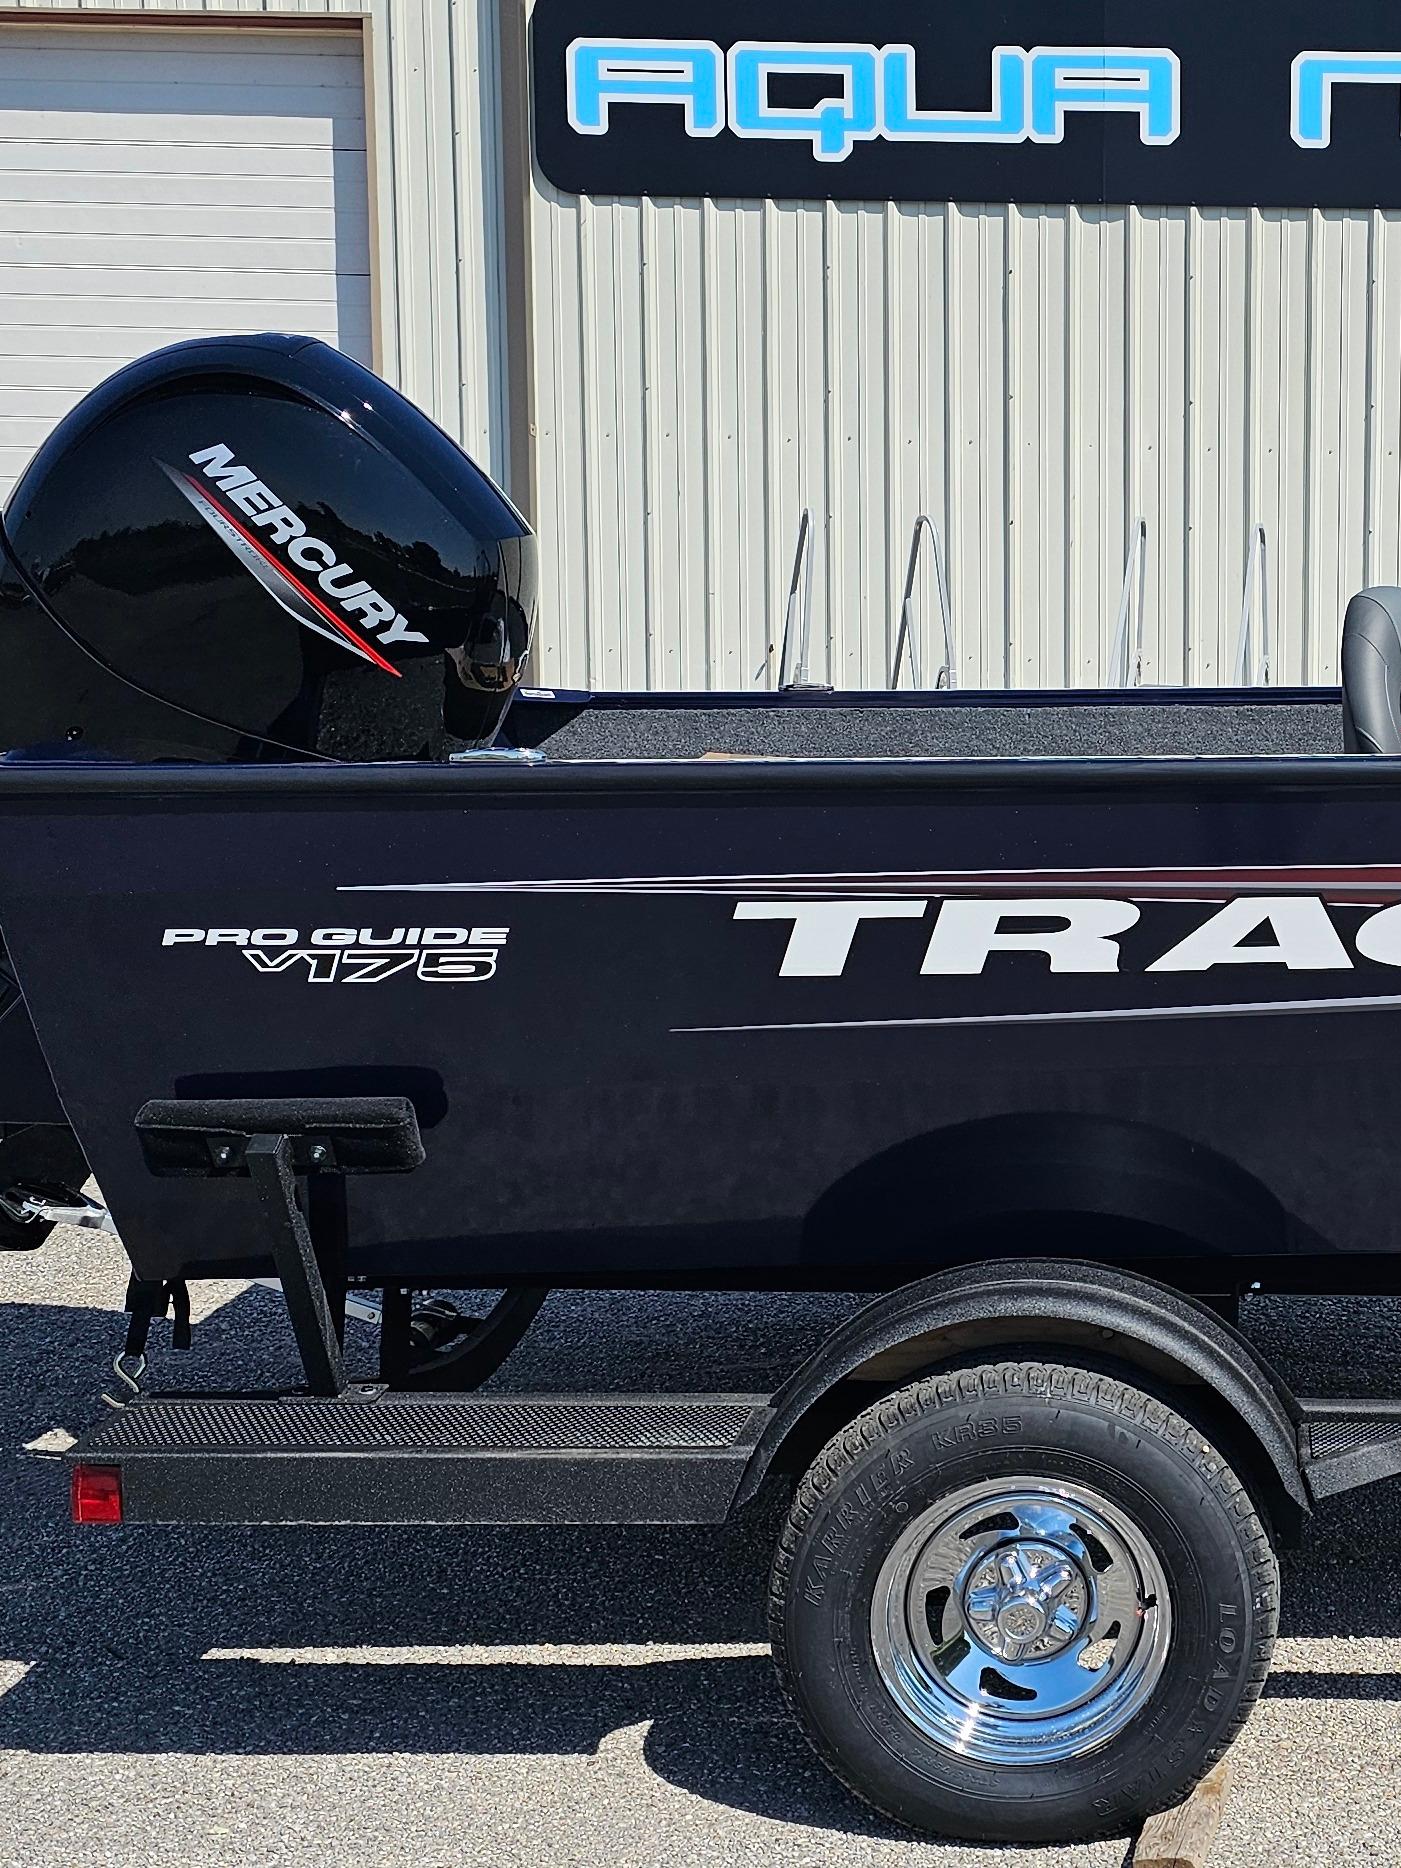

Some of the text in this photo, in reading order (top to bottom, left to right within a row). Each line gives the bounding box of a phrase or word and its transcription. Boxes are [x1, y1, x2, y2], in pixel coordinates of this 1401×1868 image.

[566, 37, 1181, 162] AQUA
[188, 443, 430, 645] MERCURY
[161, 927, 511, 946] PRO GUIDE
[241, 949, 499, 983] V175
[803, 1415, 1023, 1607] KARRIER KR35
